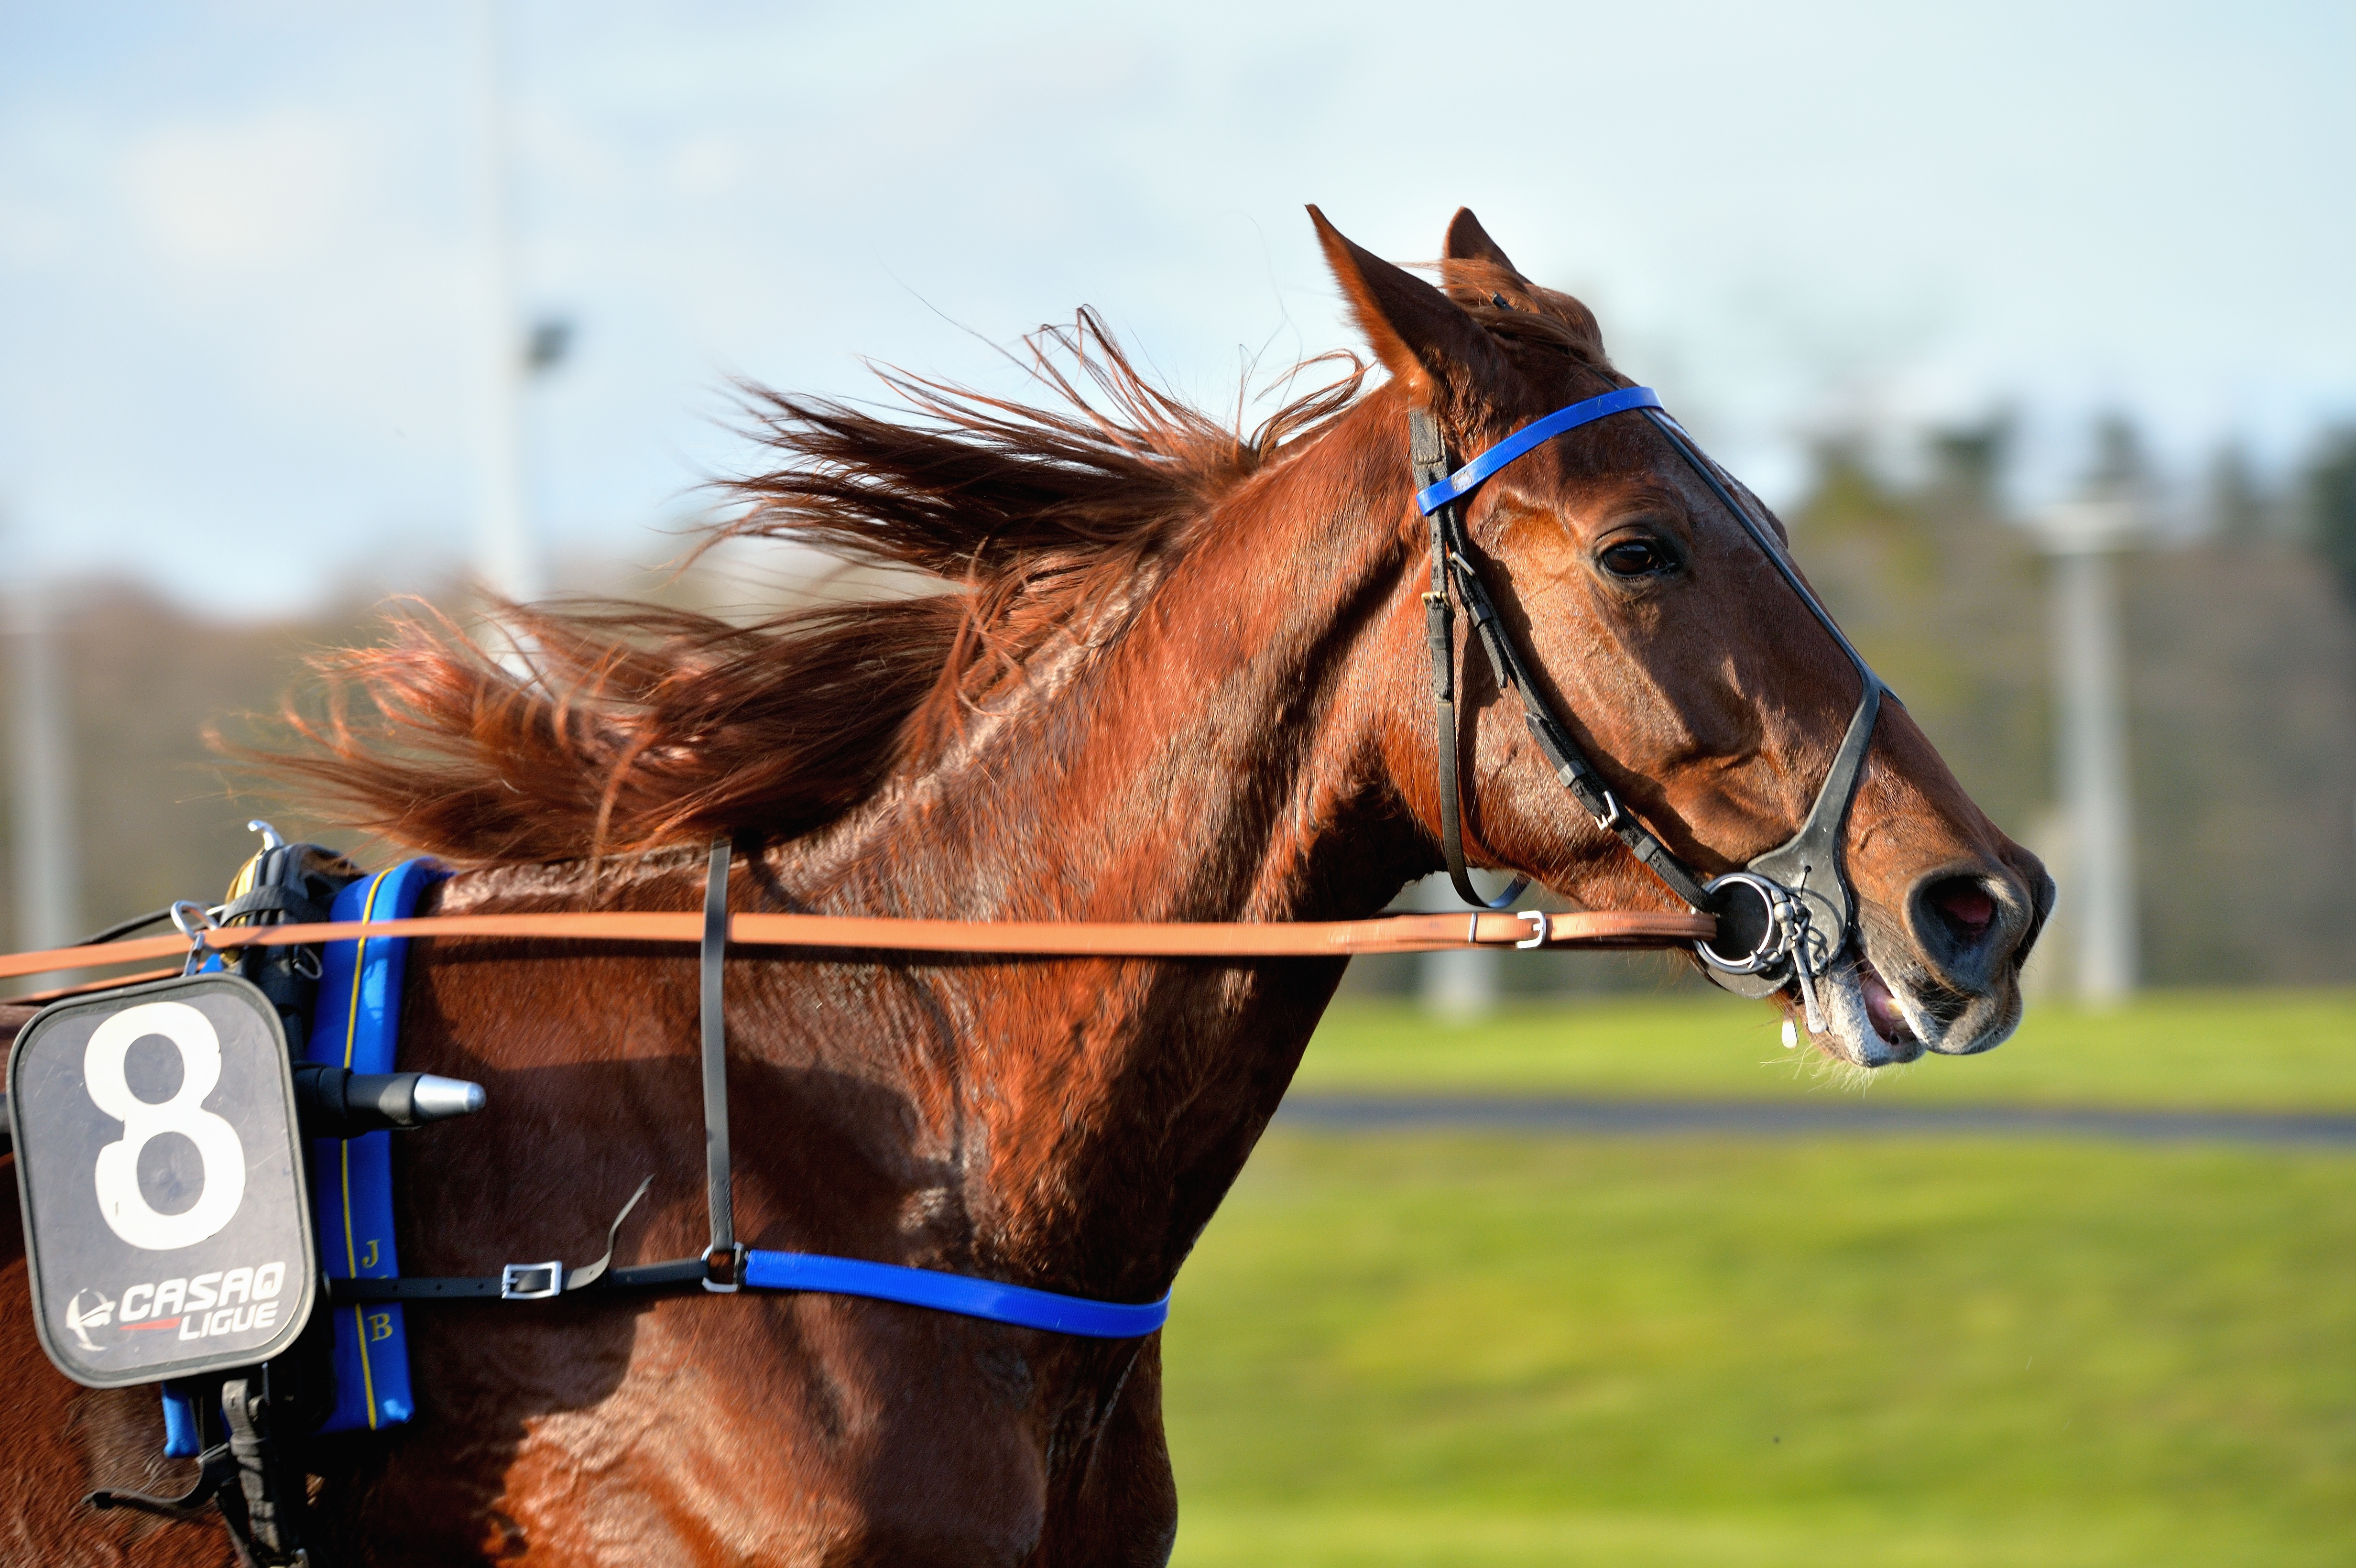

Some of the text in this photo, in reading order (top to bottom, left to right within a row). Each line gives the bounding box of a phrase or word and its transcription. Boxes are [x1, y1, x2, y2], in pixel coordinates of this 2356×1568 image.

[84, 1002, 246, 1251] 8
[119, 1261, 286, 1322] CASAQ
[178, 1301, 279, 1341] LIGUE
